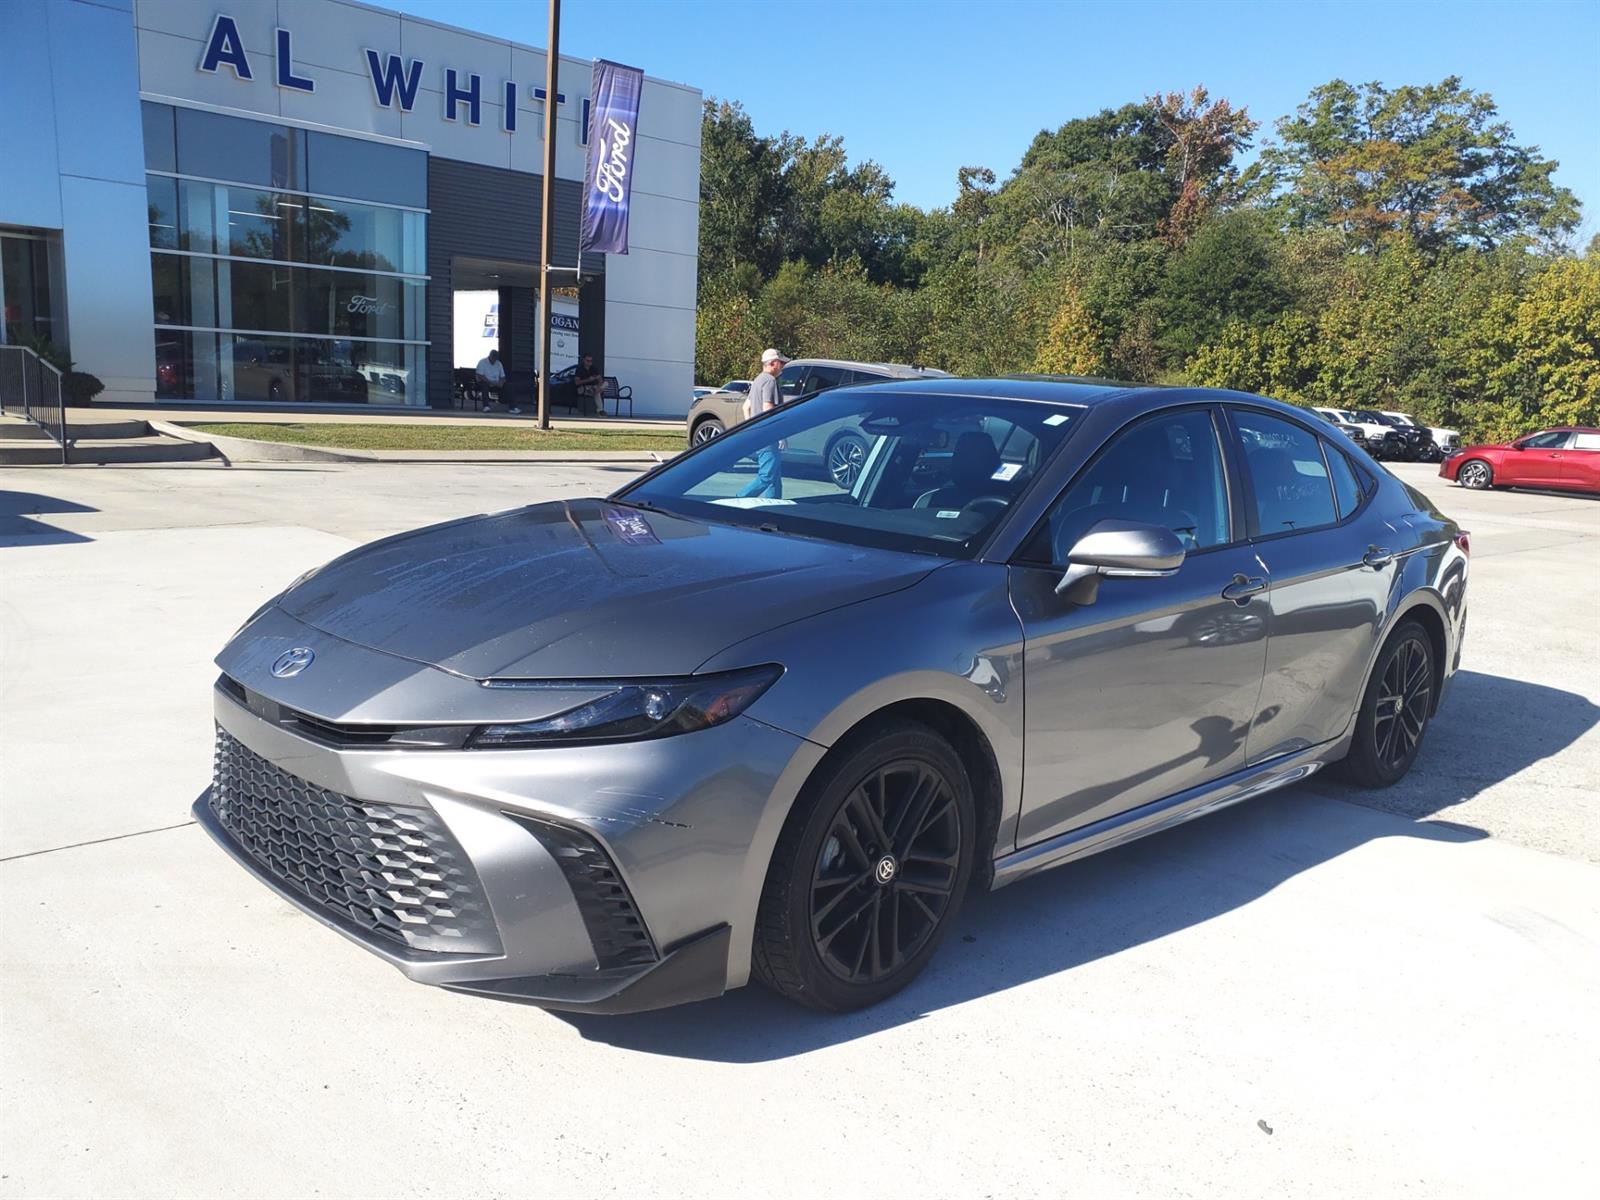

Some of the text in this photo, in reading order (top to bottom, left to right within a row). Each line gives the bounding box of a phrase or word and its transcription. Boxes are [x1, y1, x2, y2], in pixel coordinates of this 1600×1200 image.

[200, 14, 590, 146] AL WHIT
[597, 118, 630, 202] Ford
[347, 295, 387, 314] Ford
[551, 316, 579, 329] OGAN
